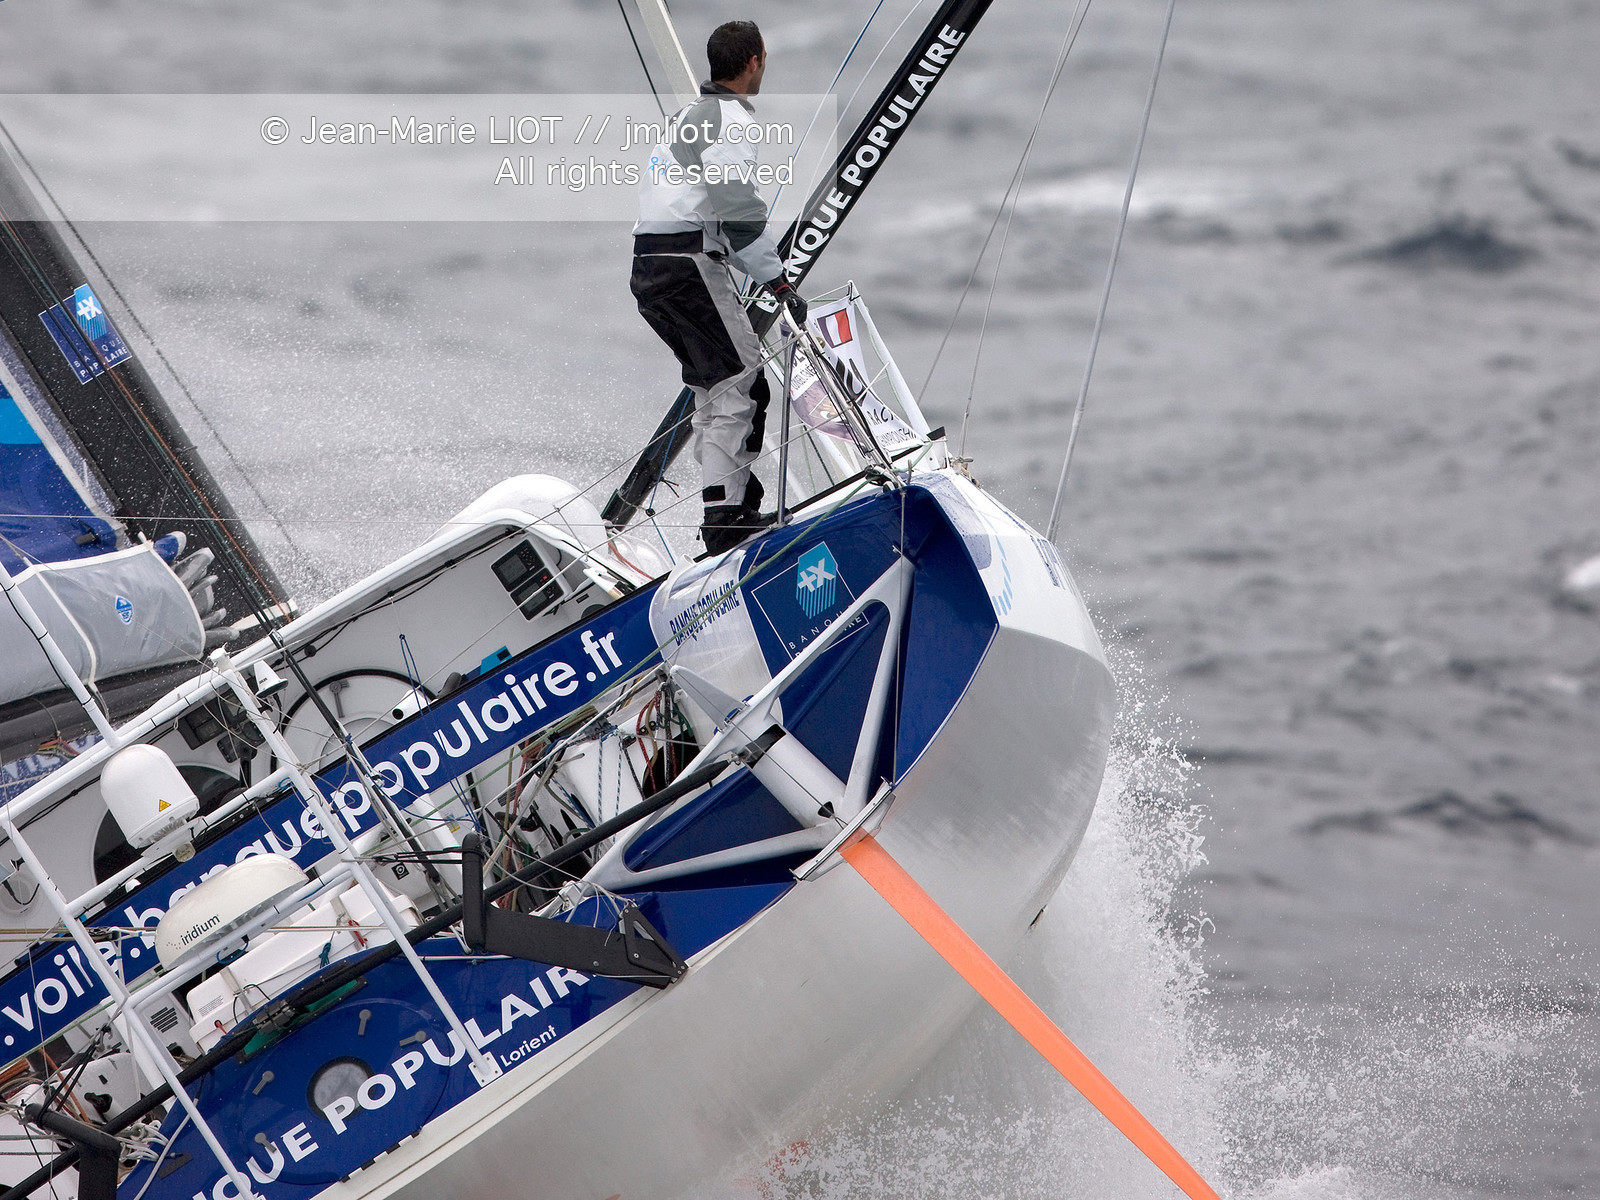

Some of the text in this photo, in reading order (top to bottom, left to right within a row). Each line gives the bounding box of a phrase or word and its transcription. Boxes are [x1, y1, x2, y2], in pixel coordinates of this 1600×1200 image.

[755, 23, 967, 314] BNQUE POPULAIRE
[73, 337, 122, 368] BAQUE
[180, 914, 221, 946] iridium
[322, 965, 599, 1135] POPULAIR
[501, 1024, 557, 1067] Lorient
